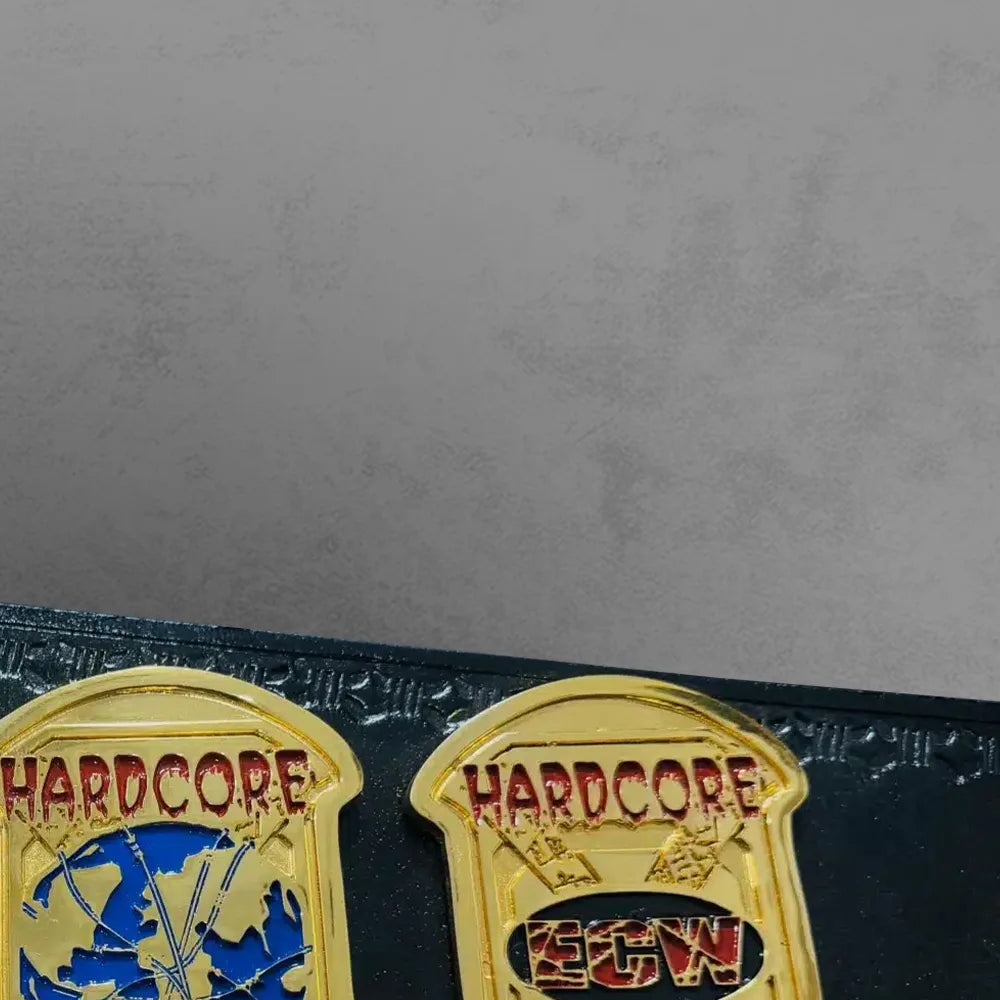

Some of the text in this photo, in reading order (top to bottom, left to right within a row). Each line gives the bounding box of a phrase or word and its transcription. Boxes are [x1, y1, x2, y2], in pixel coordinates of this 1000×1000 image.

[0, 748, 313, 821] HARDCORE
[462, 755, 763, 828] HARDCORE
[525, 916, 746, 990] ECW
